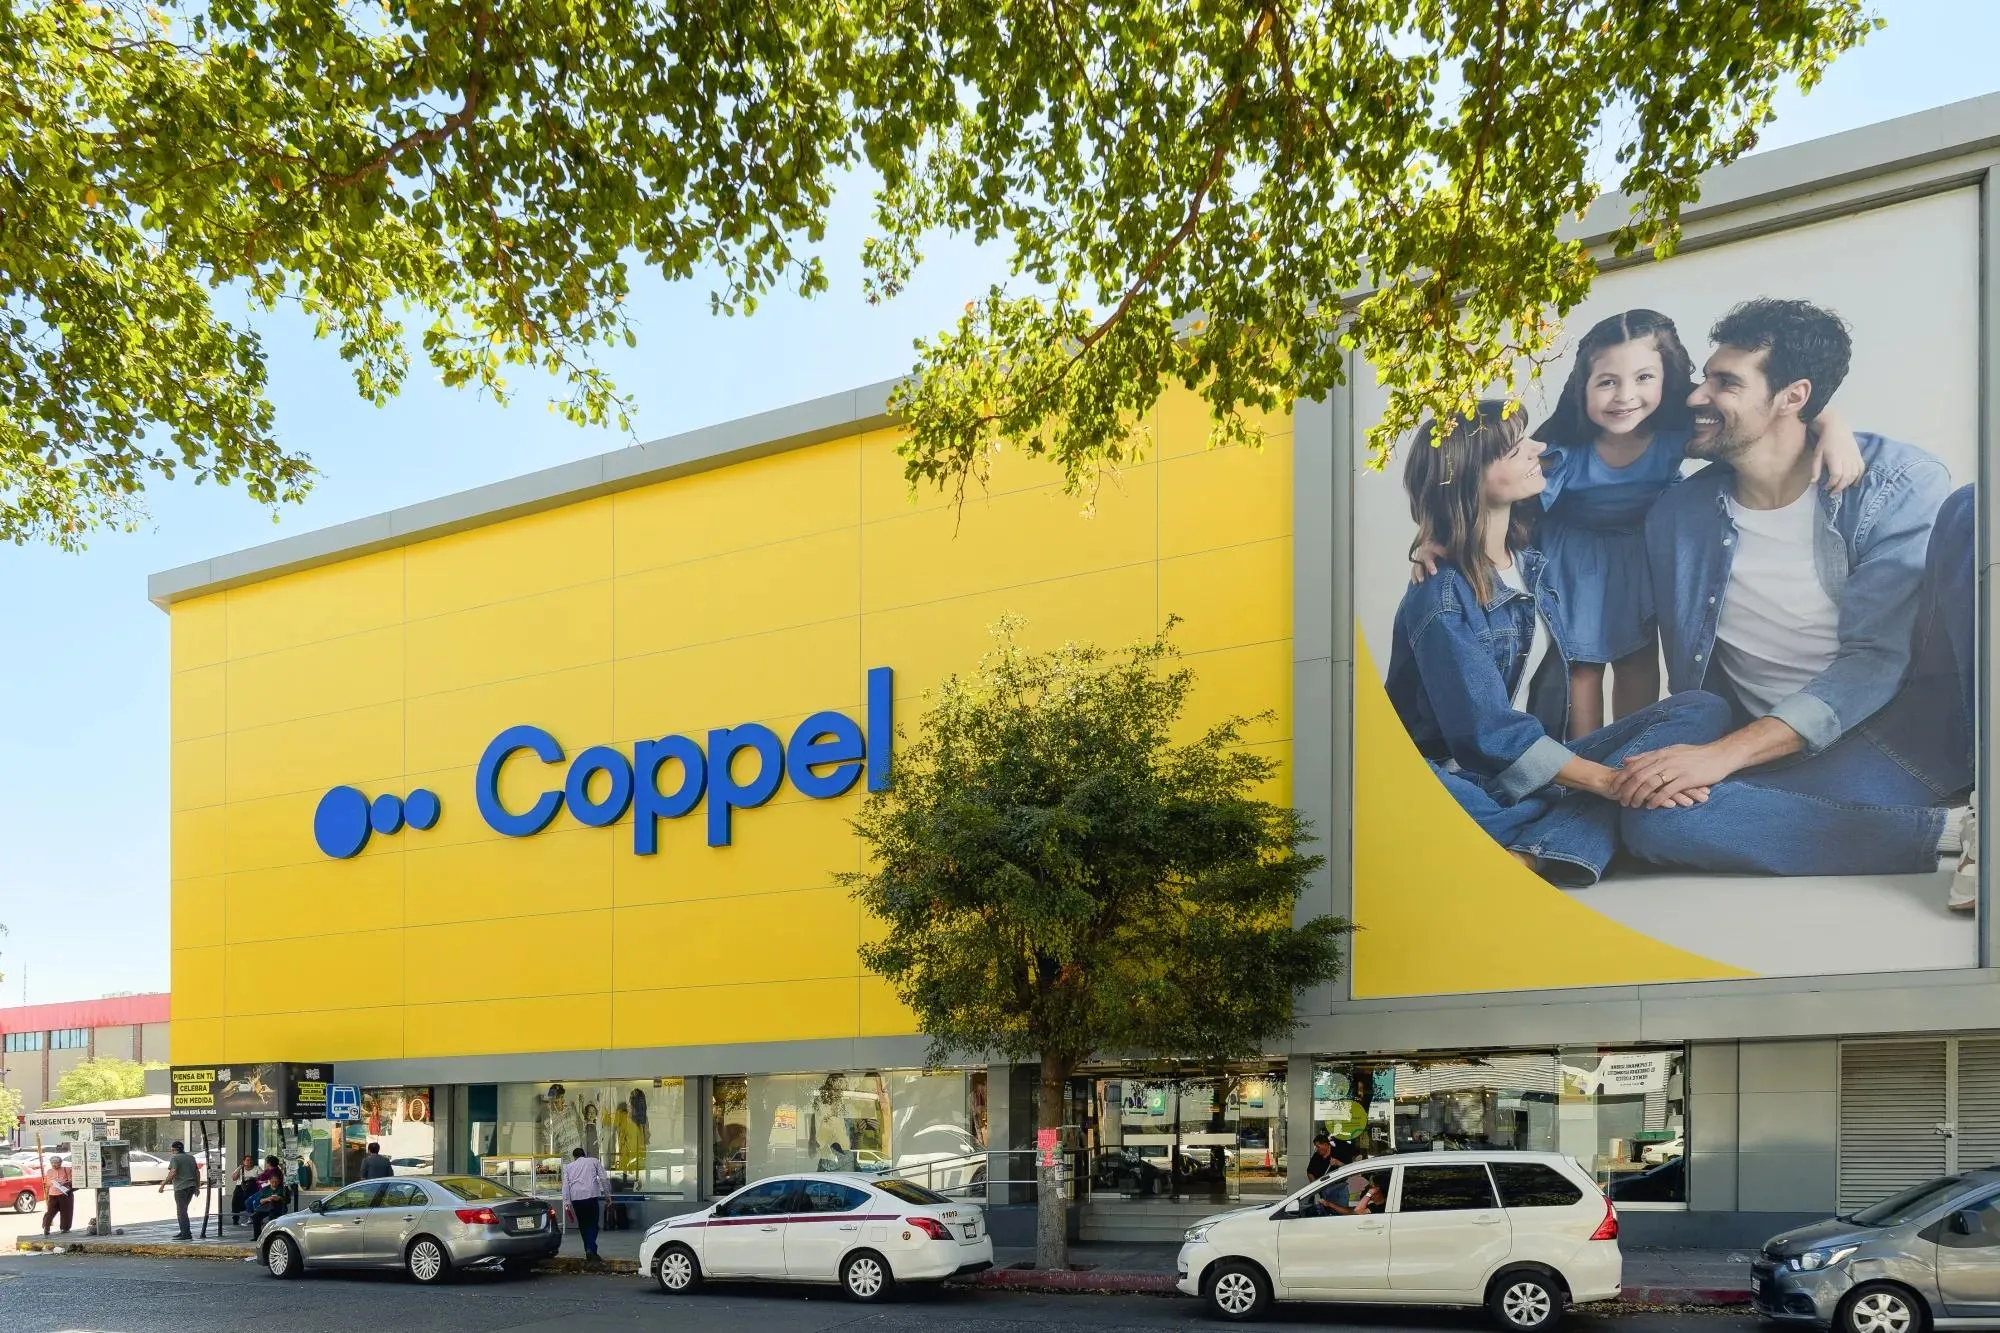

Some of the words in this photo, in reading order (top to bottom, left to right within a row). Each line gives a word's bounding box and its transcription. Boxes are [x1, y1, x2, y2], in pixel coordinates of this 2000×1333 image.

[476, 667, 893, 855] Coppel
[196, 1072, 205, 1080] EN
[180, 1084, 208, 1092] CELEBRA
[190, 1096, 213, 1104] MEDIDA
[29, 1117, 76, 1126] INSURGENTES
[107, 1128, 119, 1137] NTA
